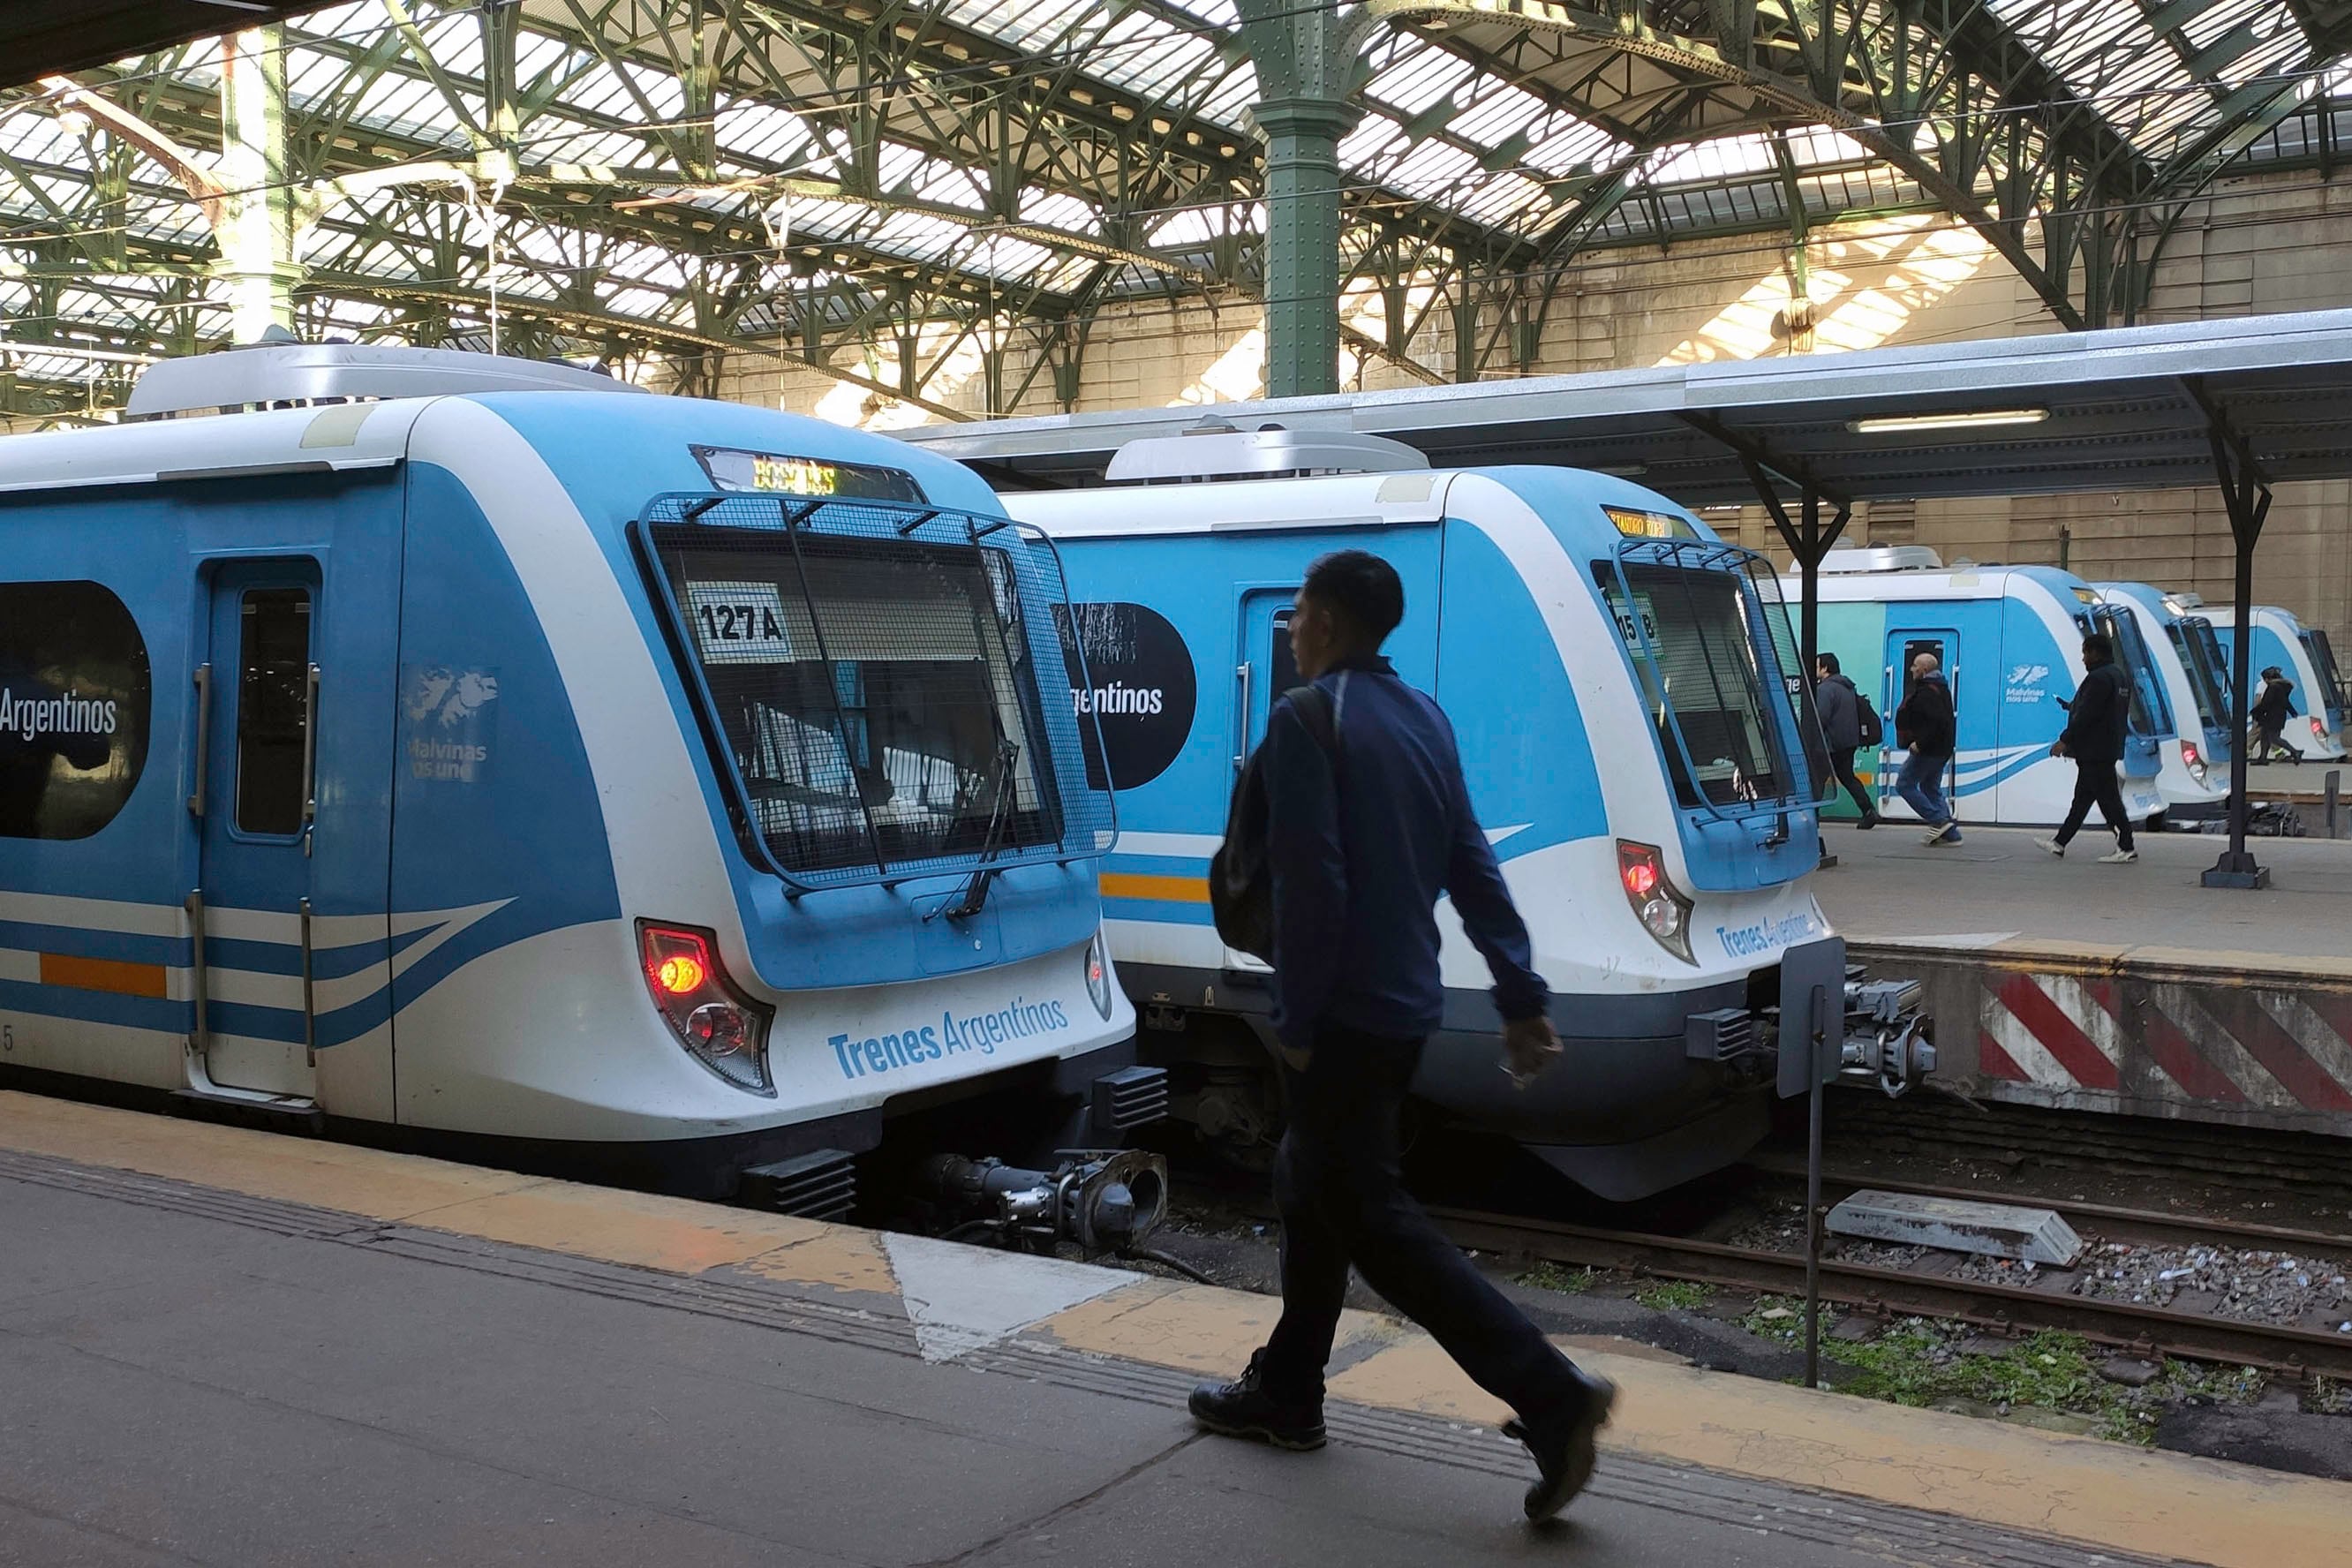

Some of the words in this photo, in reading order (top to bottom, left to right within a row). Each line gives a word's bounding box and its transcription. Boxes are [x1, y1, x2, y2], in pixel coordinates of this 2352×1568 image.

[700, 604, 784, 642] 127A
[0, 687, 117, 743] Argentinos
[1715, 925, 1764, 959] Trenes
[827, 1032, 942, 1079] Trenes
[941, 995, 1069, 1055] Argentinos
